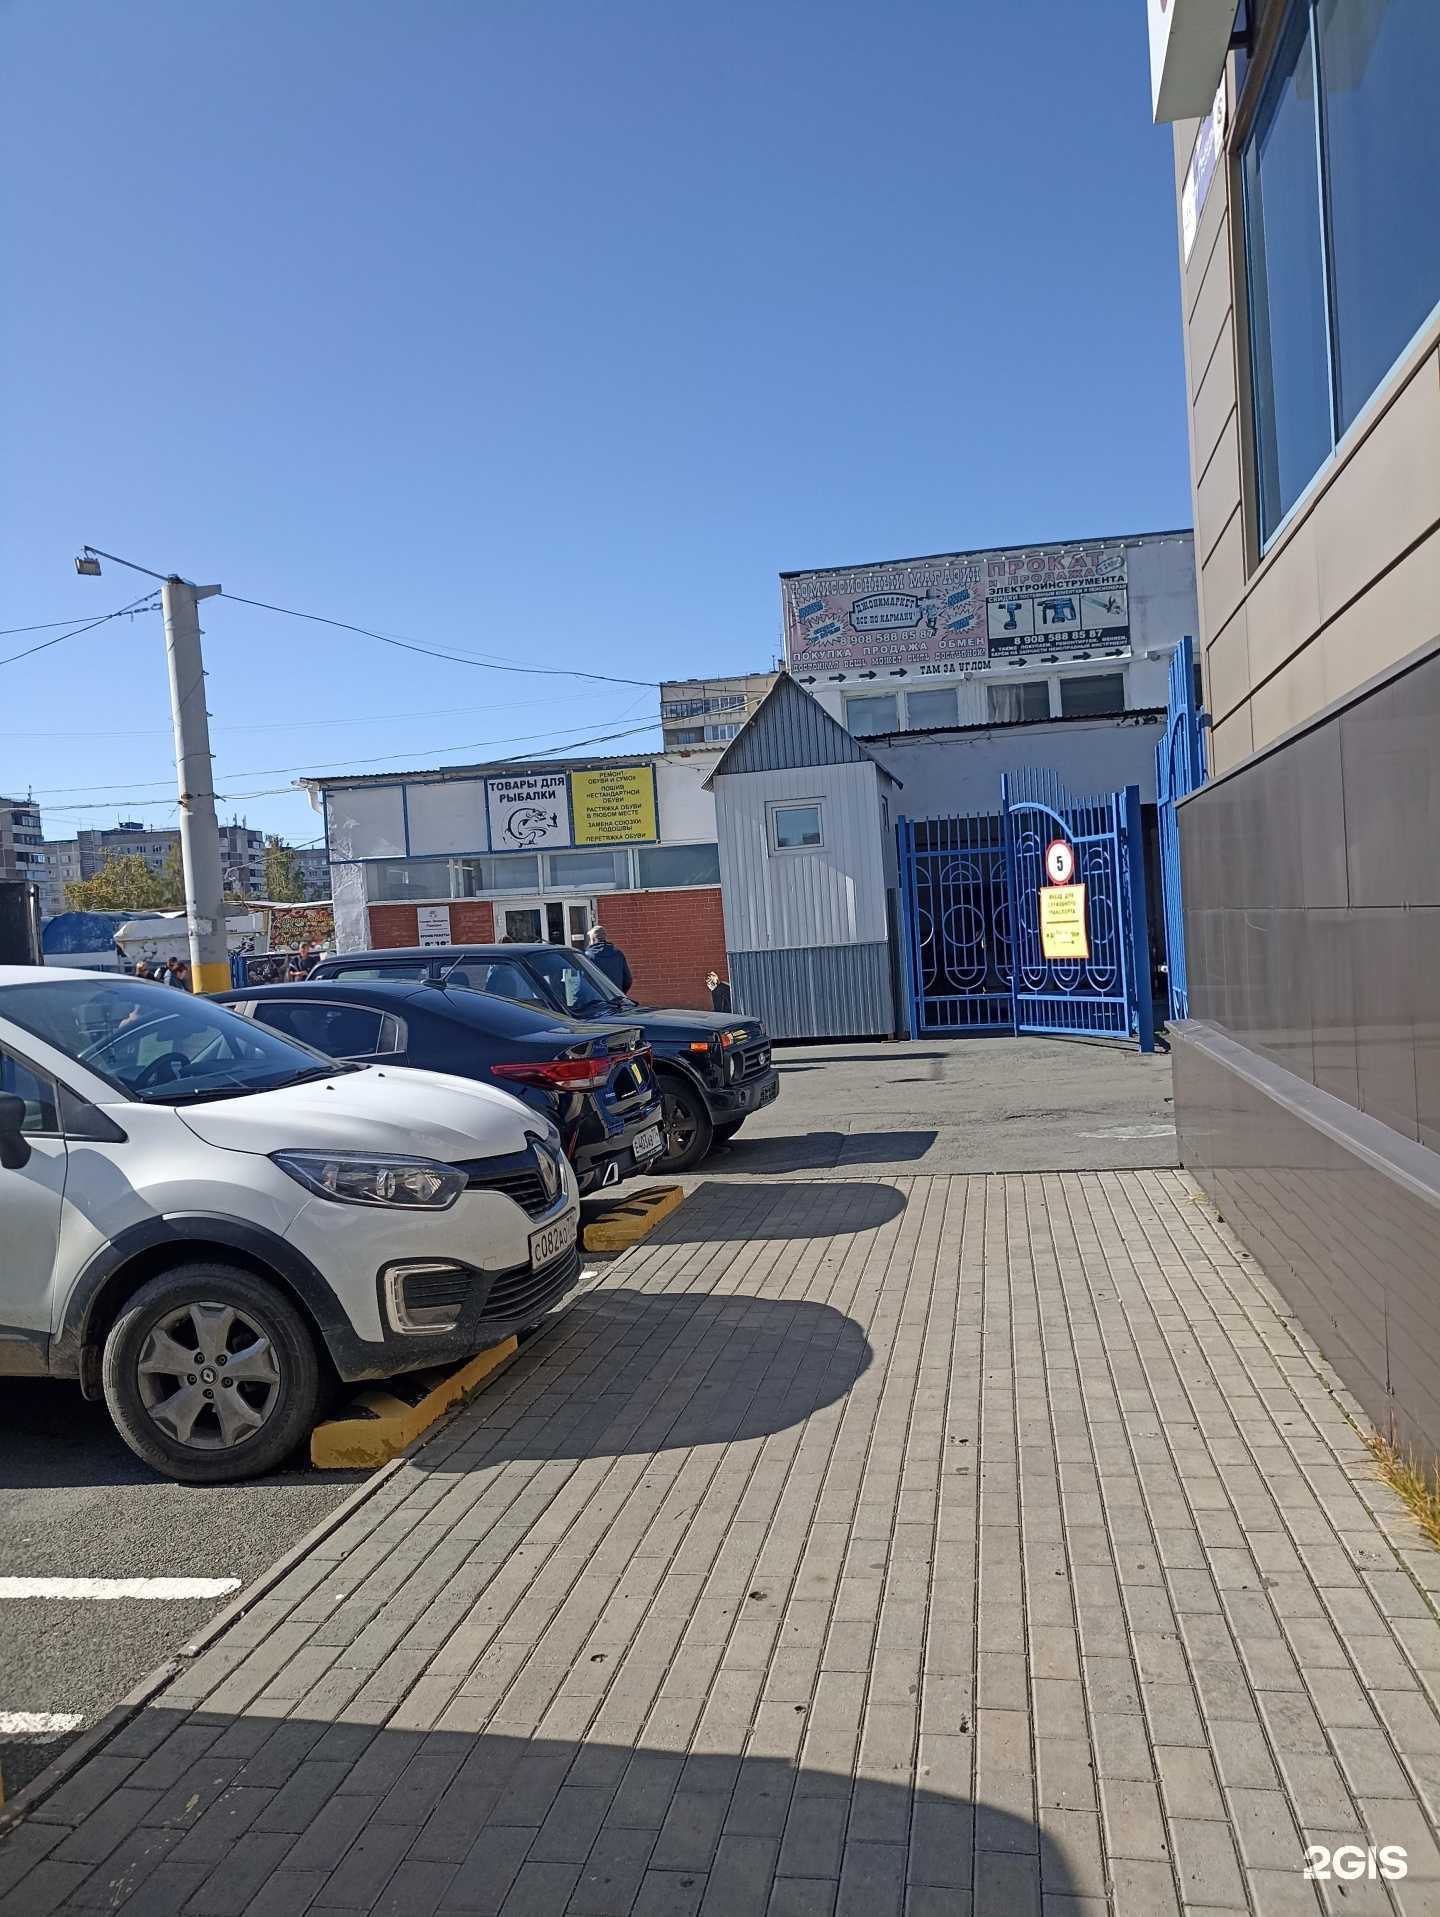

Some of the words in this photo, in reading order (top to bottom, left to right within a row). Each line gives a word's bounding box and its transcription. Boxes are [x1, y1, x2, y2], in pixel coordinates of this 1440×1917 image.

[988, 551, 1104, 577] ПРОКАТ
[792, 574, 904, 598] КОМИССИОННЫЙ
[909, 567, 980, 588] МАГАЗИН
[1008, 567, 1095, 586] ПРОДАЖА
[988, 575, 1125, 595] ЭЛЕКТРОИНСТРУМЕНТА
[988, 594, 1018, 603] СКИДКИ
[870, 615, 879, 624] ПО
[840, 638, 847, 646] 8
[851, 635, 872, 645] 908
[876, 632, 898, 642] 588
[902, 630, 916, 640] 85
[920, 629, 934, 639] 87
[1014, 637, 1021, 645] 8
[1024, 635, 1044, 644] 908
[1048, 633, 1068, 642] 588
[1072, 630, 1085, 640] 85
[1089, 629, 1103, 638] 87
[793, 649, 852, 661] ПОКУПКА
[863, 642, 928, 655] ПРОДАЖА
[939, 637, 985, 648] ОБМЕН
[872, 656, 902, 665] МОЖЕТ
[920, 664, 941, 675] ТАМ
[943, 663, 956, 673] ЗА
[959, 660, 992, 672] УГЛОМ
[489, 779, 537, 791] ТОВАРЫ
[541, 777, 565, 789] ДЛЯ
[499, 790, 556, 803] РЫБАЛКИ
[586, 789, 640, 798] НЕСТАНДАРТНОЙ
[587, 805, 619, 813] РАСТЯЖКА
[620, 803, 642, 811] ОБУВИ
[593, 811, 617, 819] ЛЮБОМ
[618, 809, 639, 817] МЕСТЕ
[599, 825, 633, 833] ПОДОШВЫ
[1056, 855, 1064, 872] 5
